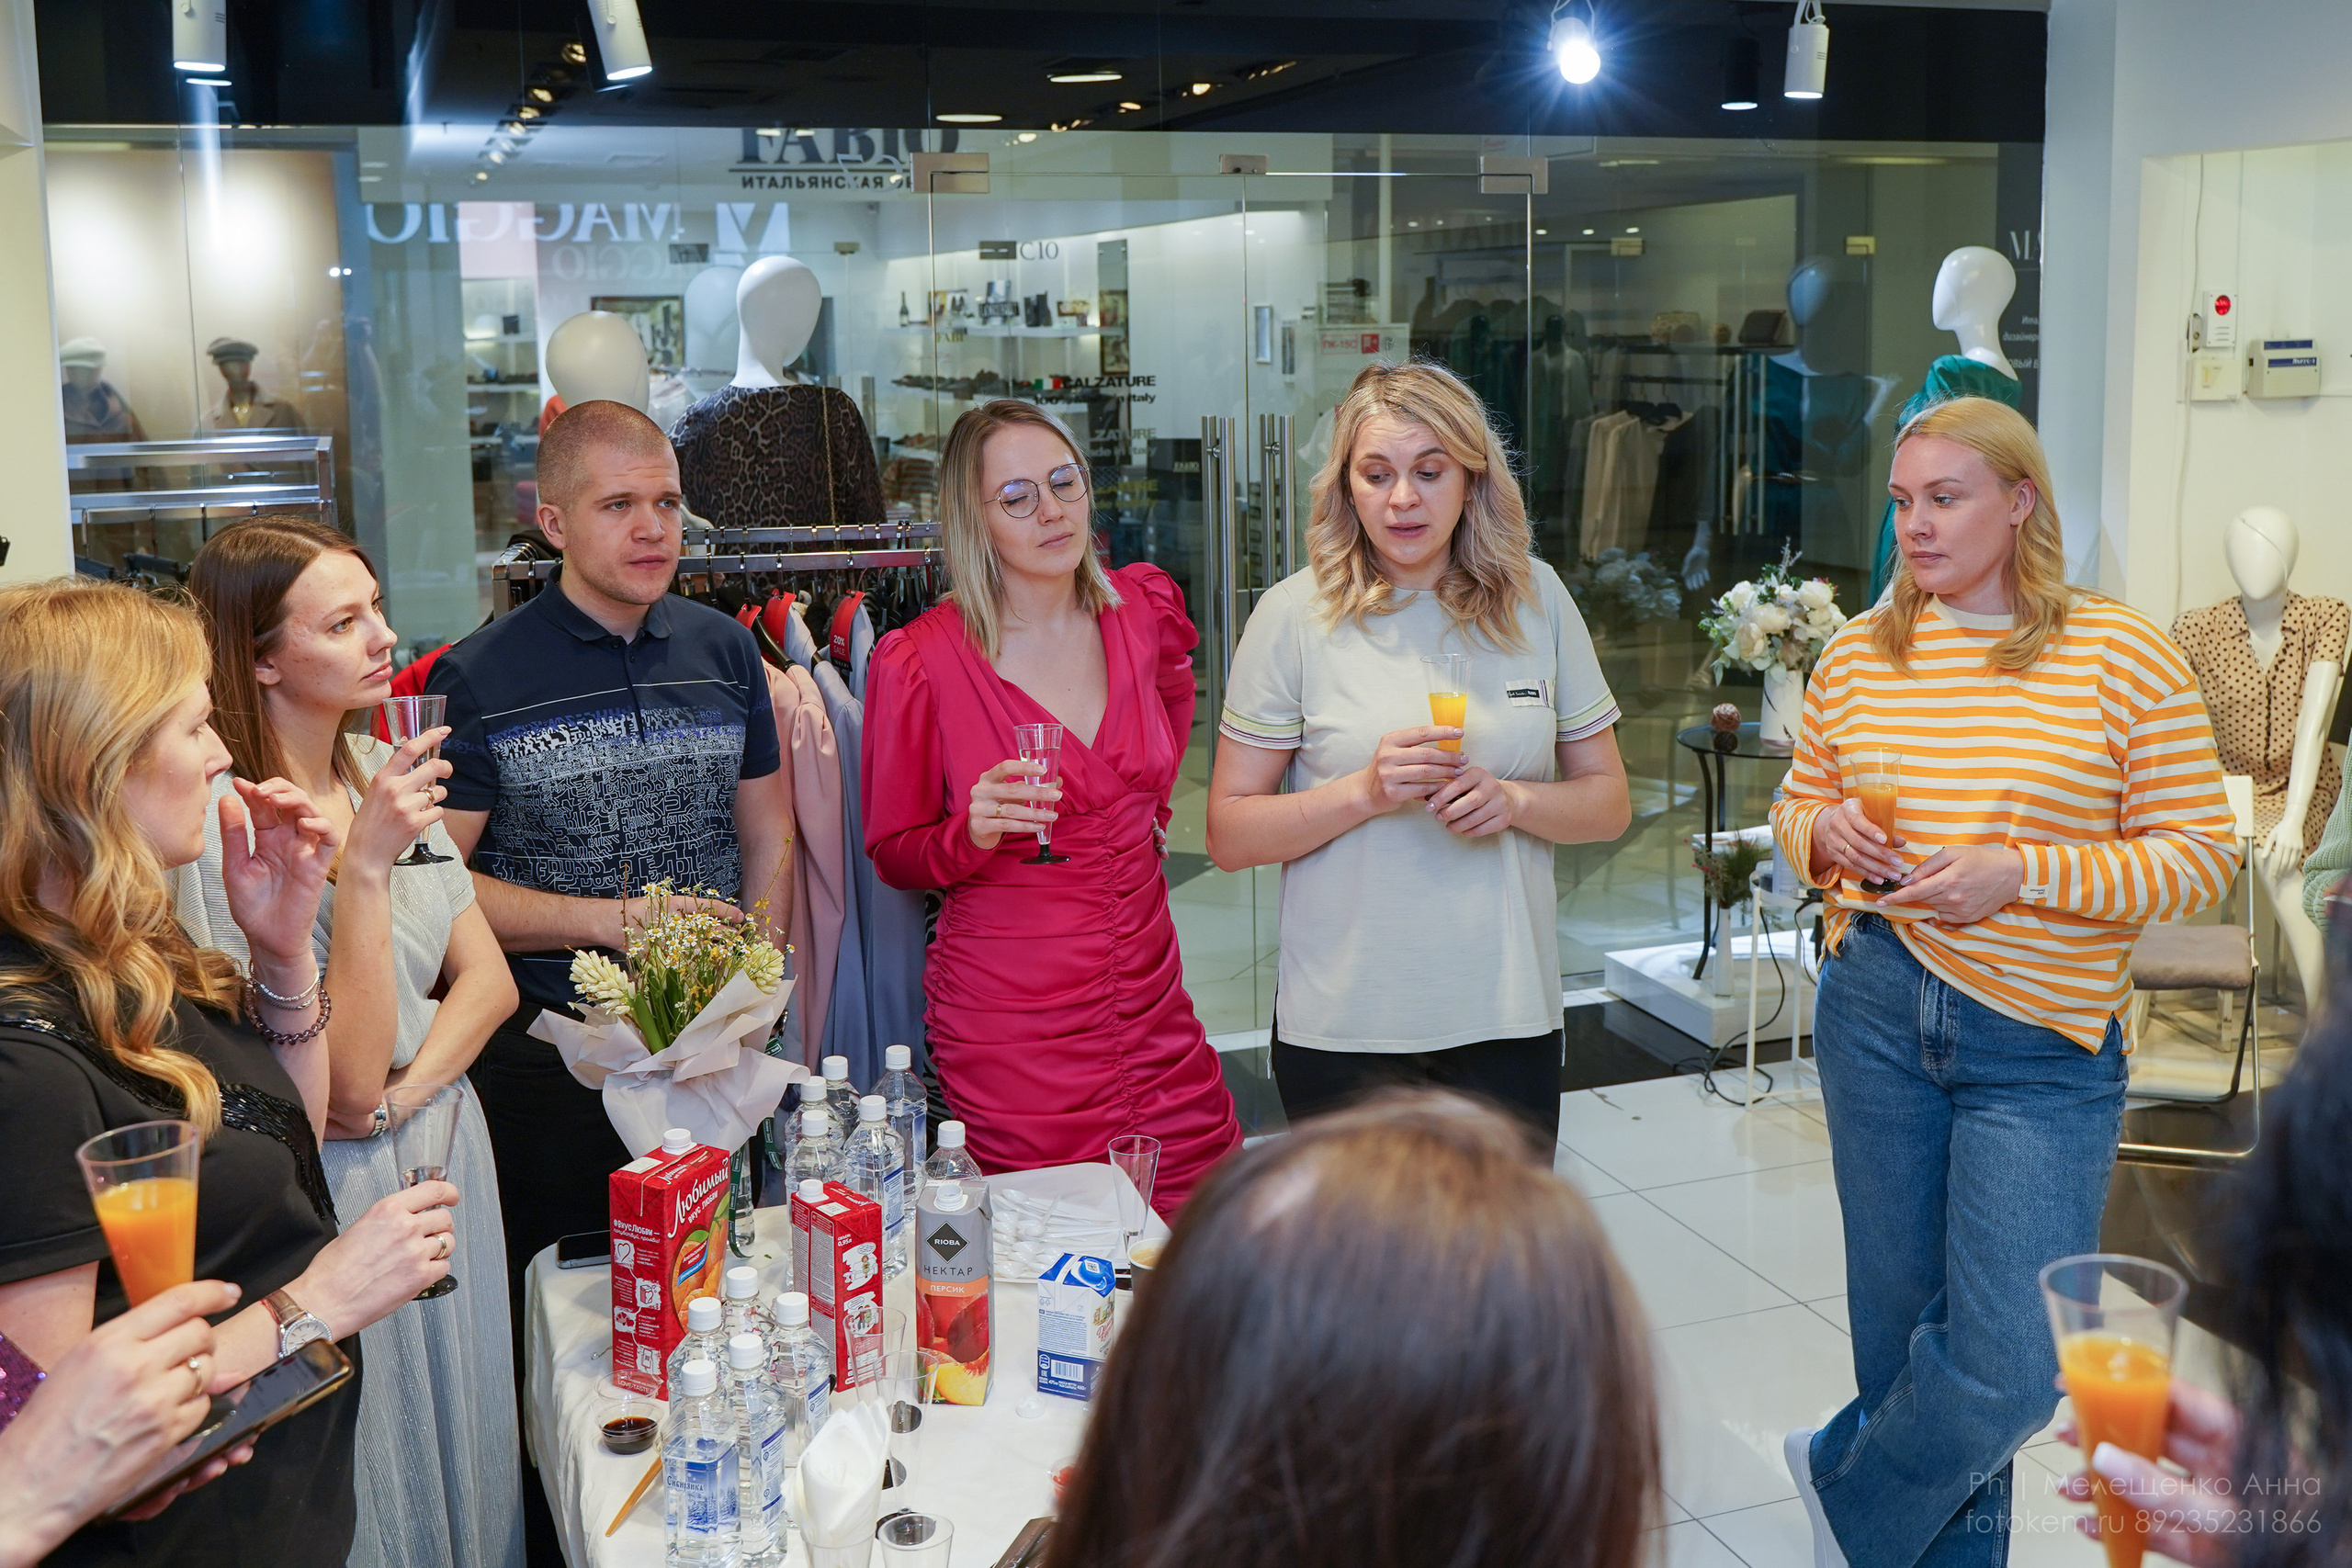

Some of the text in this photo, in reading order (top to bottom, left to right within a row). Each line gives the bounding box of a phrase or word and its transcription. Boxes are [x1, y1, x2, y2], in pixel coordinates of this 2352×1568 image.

[699, 709, 722, 719] BOSS
[669, 1157, 729, 1238] Любимый
[933, 1238, 961, 1247] RIOBA
[923, 1265, 973, 1277] НЕКТАР
[930, 1284, 965, 1293] ПЕРСИК
